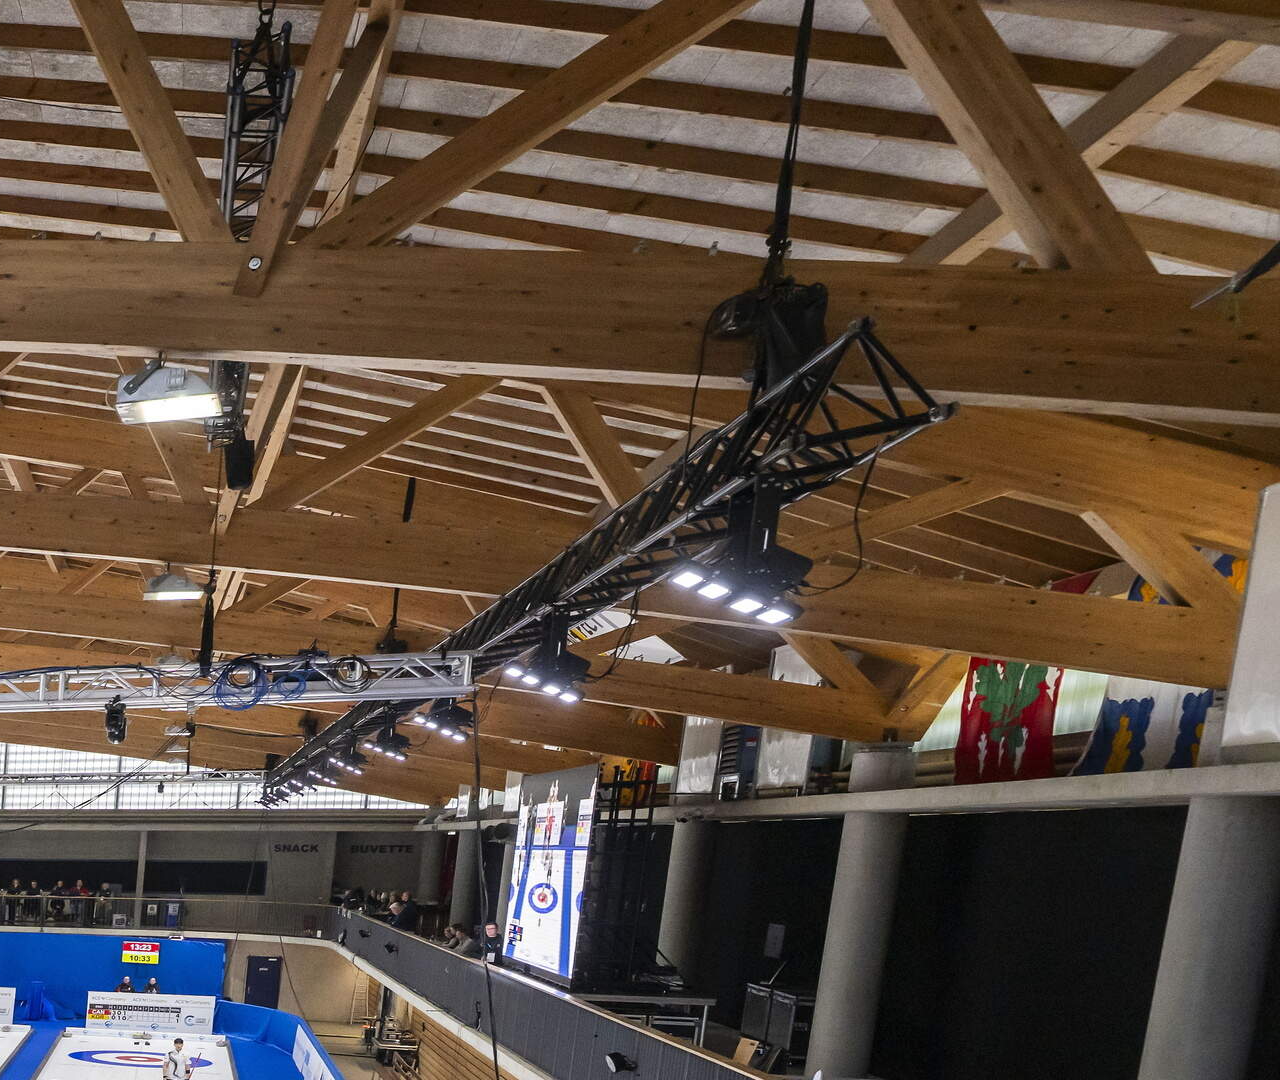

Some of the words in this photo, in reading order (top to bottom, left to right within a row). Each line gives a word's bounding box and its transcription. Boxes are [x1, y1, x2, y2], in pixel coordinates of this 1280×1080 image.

[273, 843, 320, 854] SNACK
[351, 844, 415, 854] BUVETTE
[129, 943, 153, 951] 13:23
[129, 954, 151, 962] 10:33
